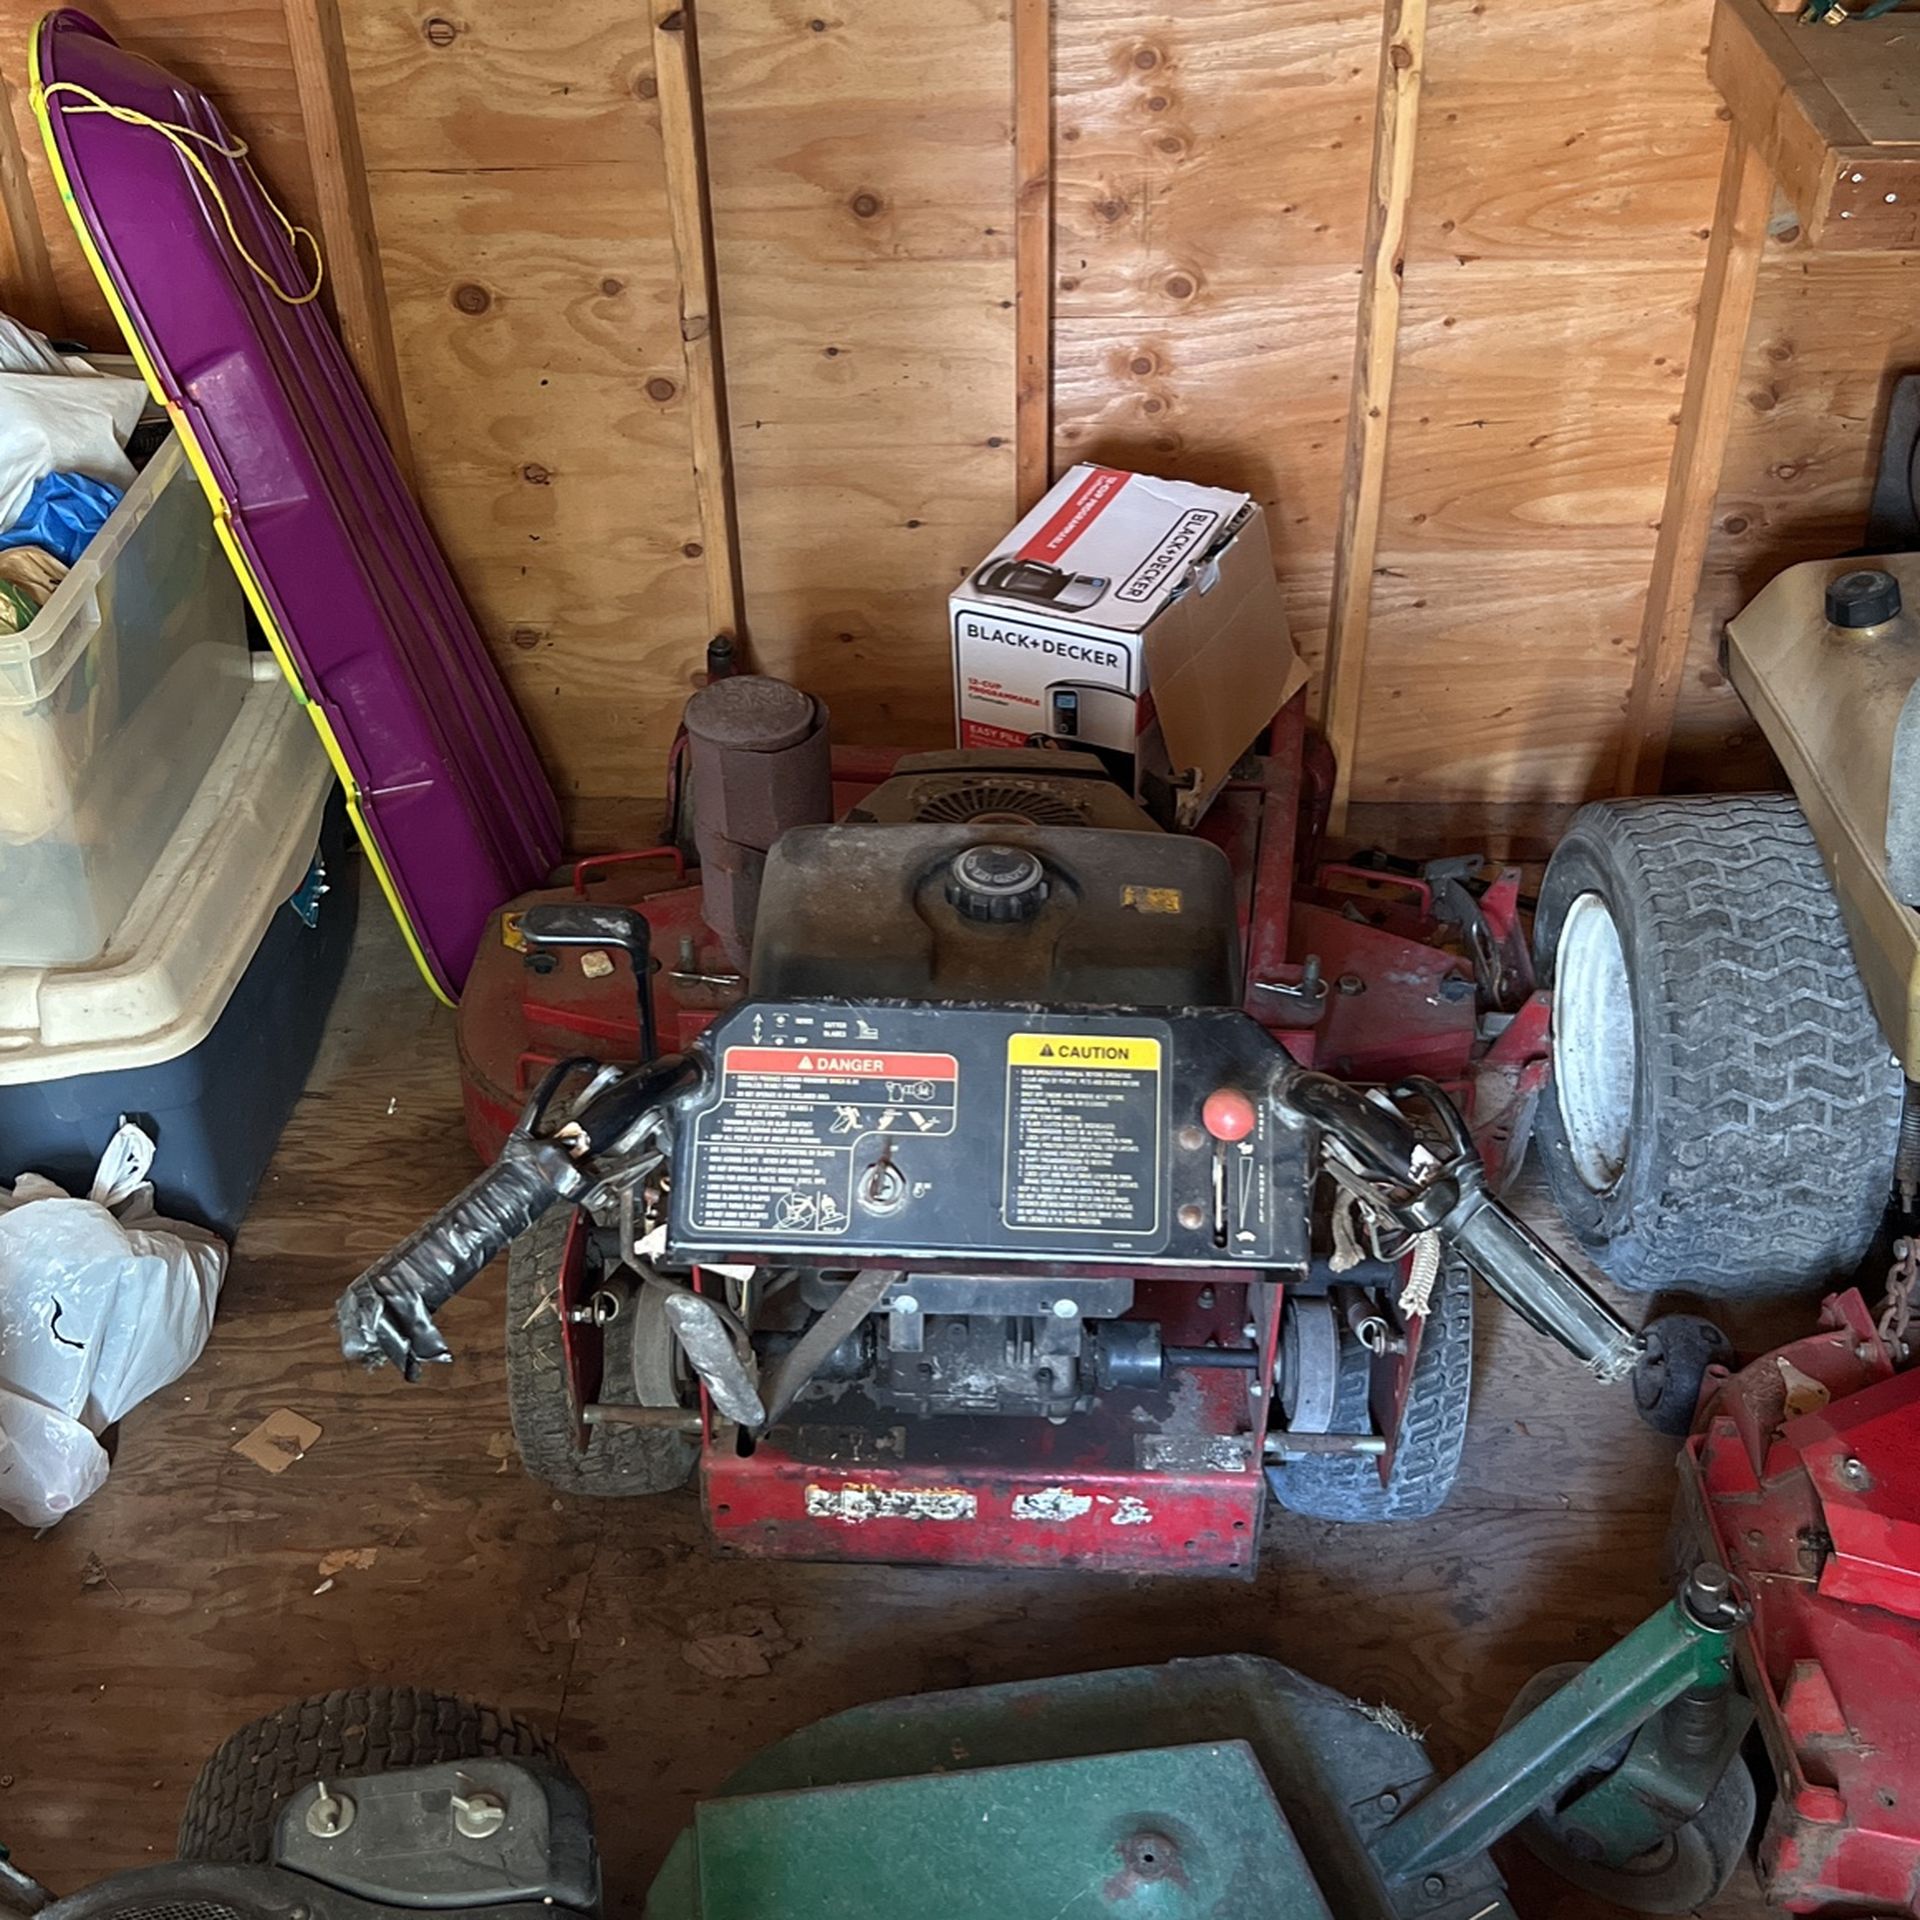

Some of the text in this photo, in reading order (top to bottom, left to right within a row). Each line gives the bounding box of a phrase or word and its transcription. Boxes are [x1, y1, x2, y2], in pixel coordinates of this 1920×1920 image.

[1126, 513, 1208, 598] BLACK+DECKER
[967, 623, 1119, 668] BLACK+DECKER
[969, 725, 998, 738] EASY
[1058, 1044, 1130, 1060] CAUTION
[817, 1057, 884, 1072] DANGER
